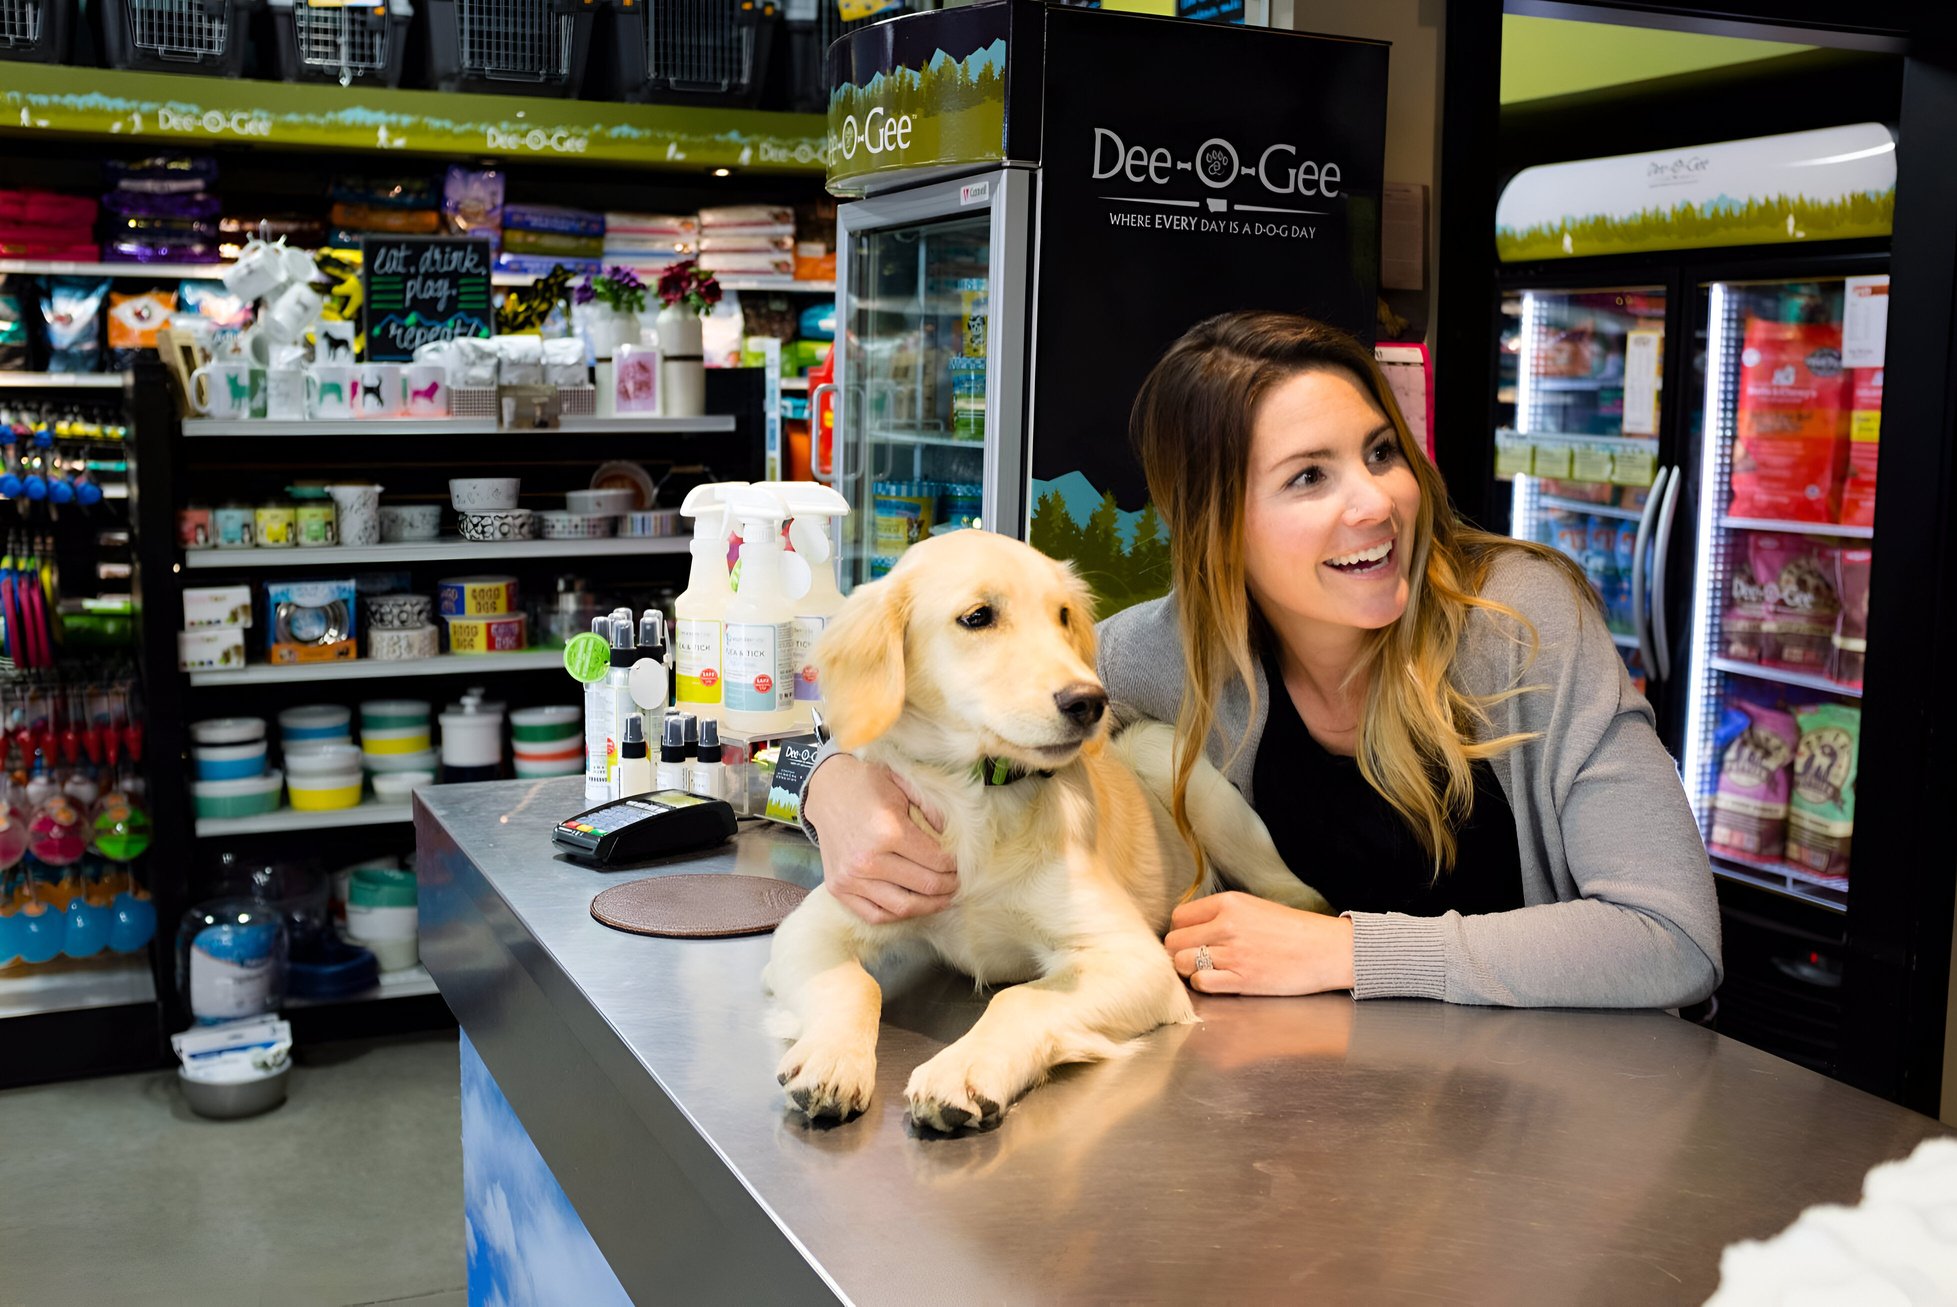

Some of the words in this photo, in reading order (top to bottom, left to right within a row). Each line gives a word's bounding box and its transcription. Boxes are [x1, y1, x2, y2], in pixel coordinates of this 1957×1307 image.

[158, 107, 272, 136] Dee-O-Gee
[486, 126, 588, 153] Dee-O-Gee
[828, 107, 913, 168] ee-O-Gee
[1092, 127, 1341, 198] Dee-O-Gee
[1109, 212, 1151, 228] WHERE
[1155, 214, 1198, 231] EVERY
[1201, 219, 1226, 233] DAY
[1229, 220, 1239, 234] IS
[1242, 222, 1251, 235] A
[1291, 225, 1316, 240] DAY
[746, 649, 765, 658] TICK
